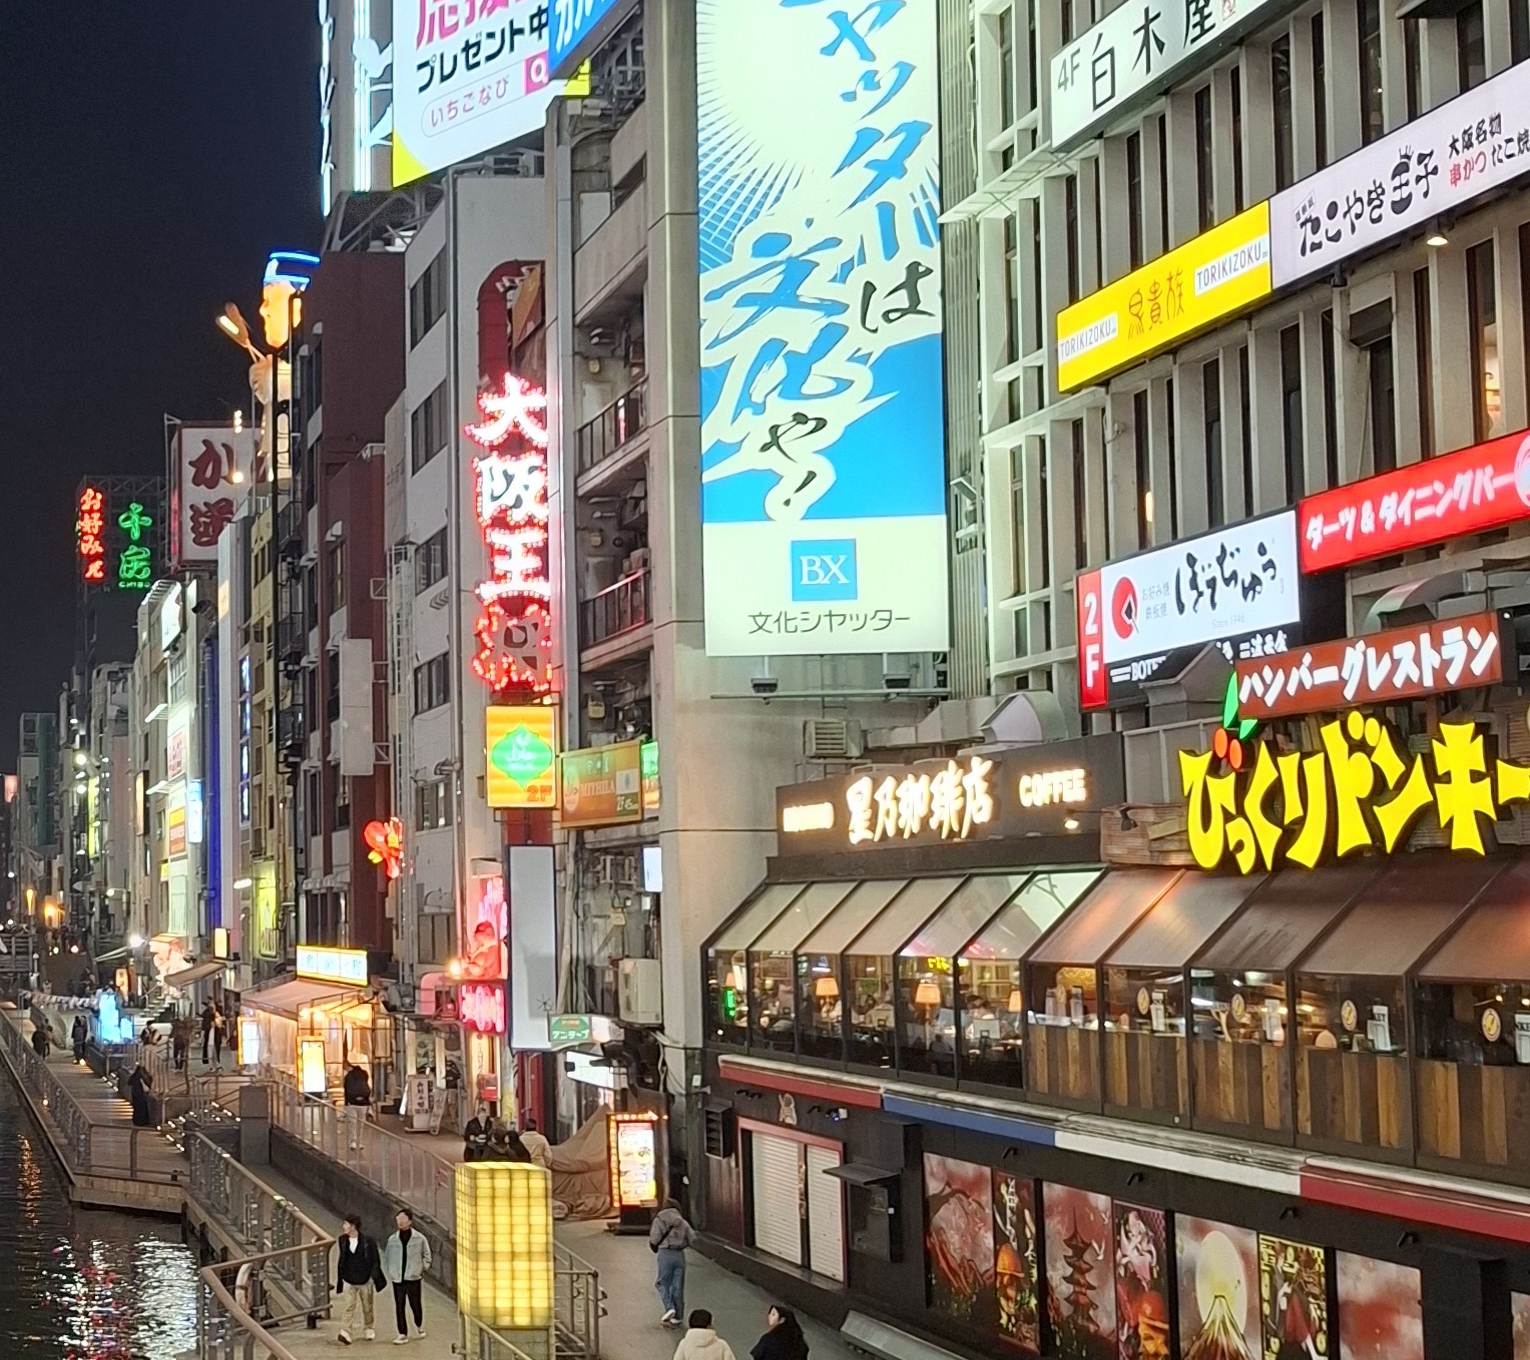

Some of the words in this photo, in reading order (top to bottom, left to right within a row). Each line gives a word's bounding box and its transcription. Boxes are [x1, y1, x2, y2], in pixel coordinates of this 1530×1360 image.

[416, 6, 548, 95] プレゼント中
[1057, 50, 1082, 95] 4F
[431, 77, 509, 126] いちごなび
[1448, 111, 1502, 159] 大阪名物
[1299, 144, 1440, 258] たこやき王子
[1449, 150, 1488, 189] 串かつ
[1197, 240, 1263, 290] TORIKIZOKU
[1059, 319, 1112, 358] TORIKIZOKU
[1127, 266, 1185, 340] 鳥貴族
[118, 502, 153, 580] 千房
[1305, 506, 1359, 553] ダーツ
[1360, 502, 1376, 534] &
[1379, 467, 1514, 535] ダイニングバー
[800, 556, 848, 588] BX
[1174, 541, 1278, 616] ぼてぢゅう
[748, 609, 911, 637] 文化シヤッター
[1084, 592, 1100, 689] 2F
[1238, 626, 1498, 706] ハンバーグレストラン
[526, 786, 552, 802] 2F
[845, 756, 994, 845] 星乃珈琲店
[1019, 768, 1087, 808] COFFEE
[1178, 710, 1530, 875] びっくりドンキー
